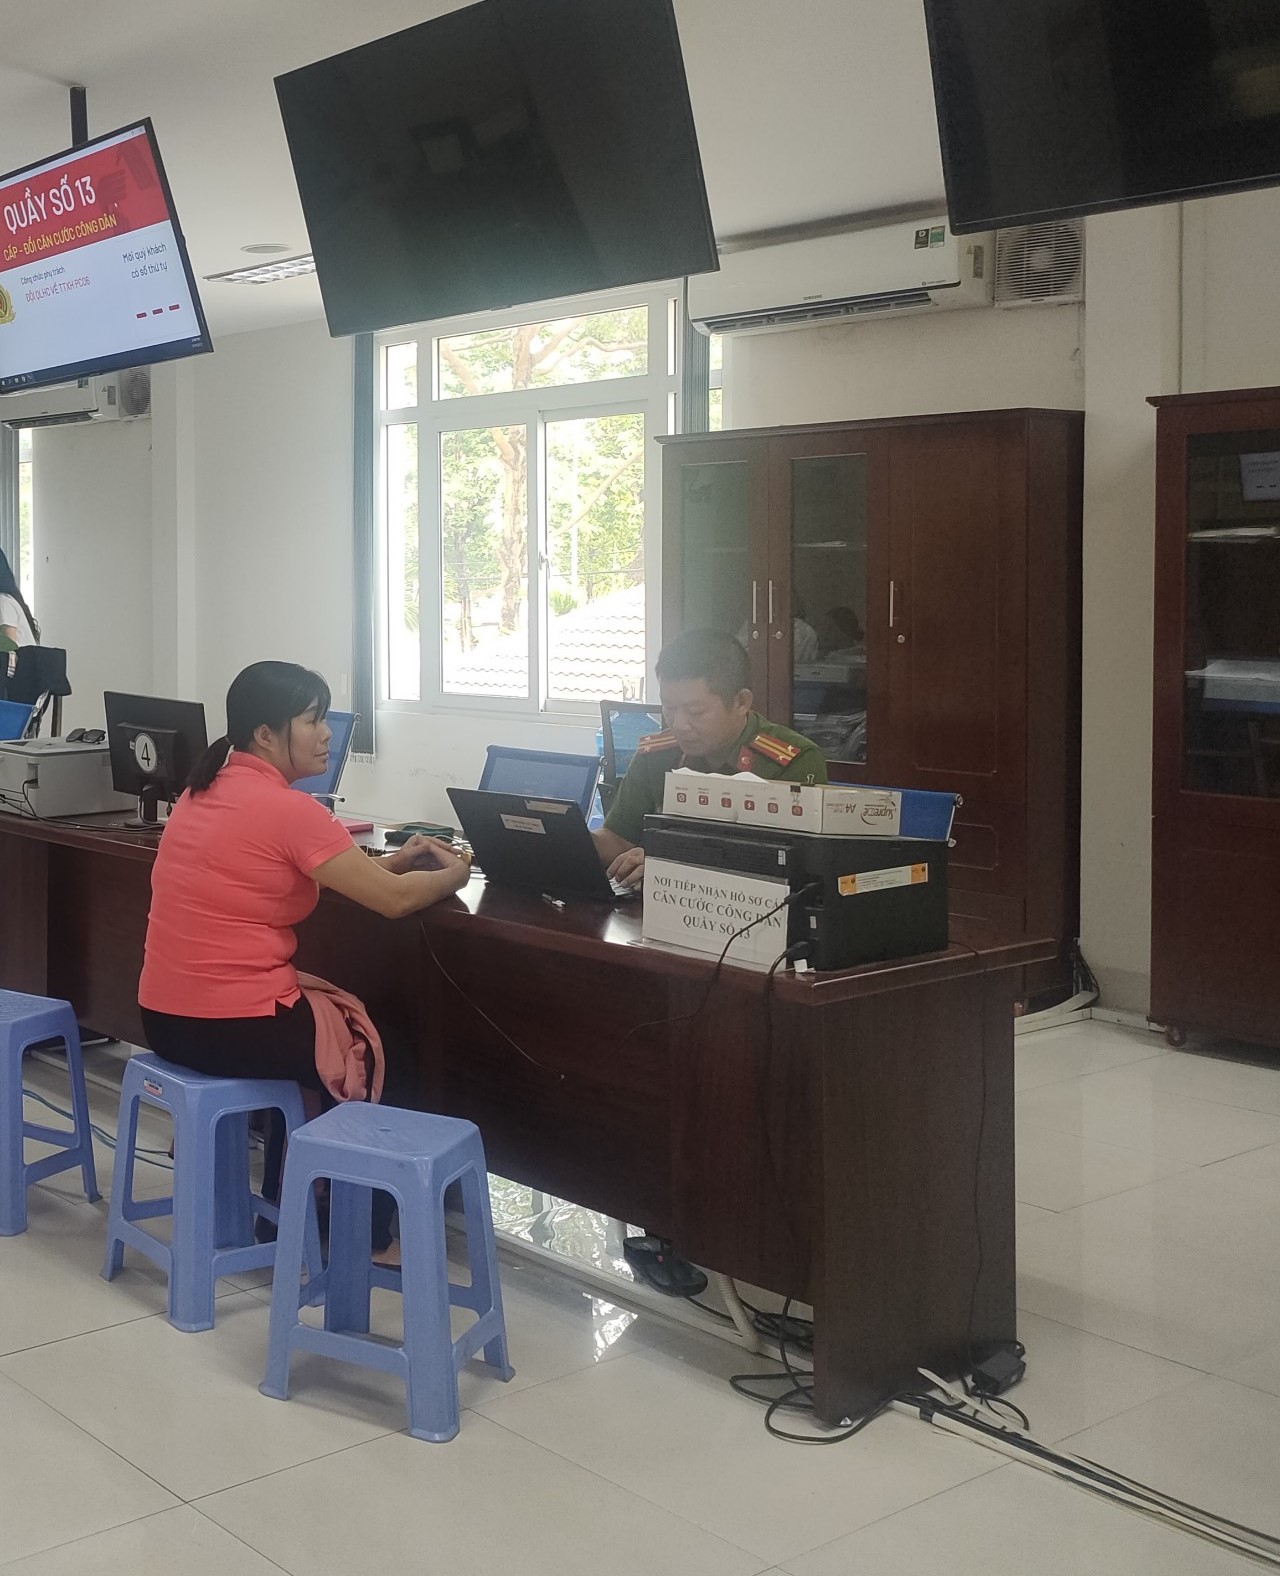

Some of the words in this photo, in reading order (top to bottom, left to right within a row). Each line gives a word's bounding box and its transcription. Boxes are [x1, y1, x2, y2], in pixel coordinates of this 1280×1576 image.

[3, 187, 47, 235] QUẦY
[49, 174, 75, 216] SỐ
[75, 175, 96, 207] 13
[3, 243, 18, 261] CẤP
[23, 236, 37, 255] ĐỔI
[37, 234, 54, 251] CĂN
[53, 226, 76, 246] CƯỚC
[75, 220, 99, 238] CÔNG
[98, 213, 118, 231] DÂN
[141, 742, 151, 767] 4
[845, 804, 857, 814] A4
[653, 890, 677, 905] CĂN
[679, 896, 714, 913] CƯỚC
[716, 903, 752, 922] CÔNG
[654, 875, 671, 886] NƠI
[673, 879, 696, 892] TIẾP
[699, 884, 727, 900] NHẬN
[730, 890, 746, 903] HỒ
[748, 895, 763, 907] SƠ
[683, 915, 717, 931] QUẦY
[719, 922, 735, 936] SỐ
